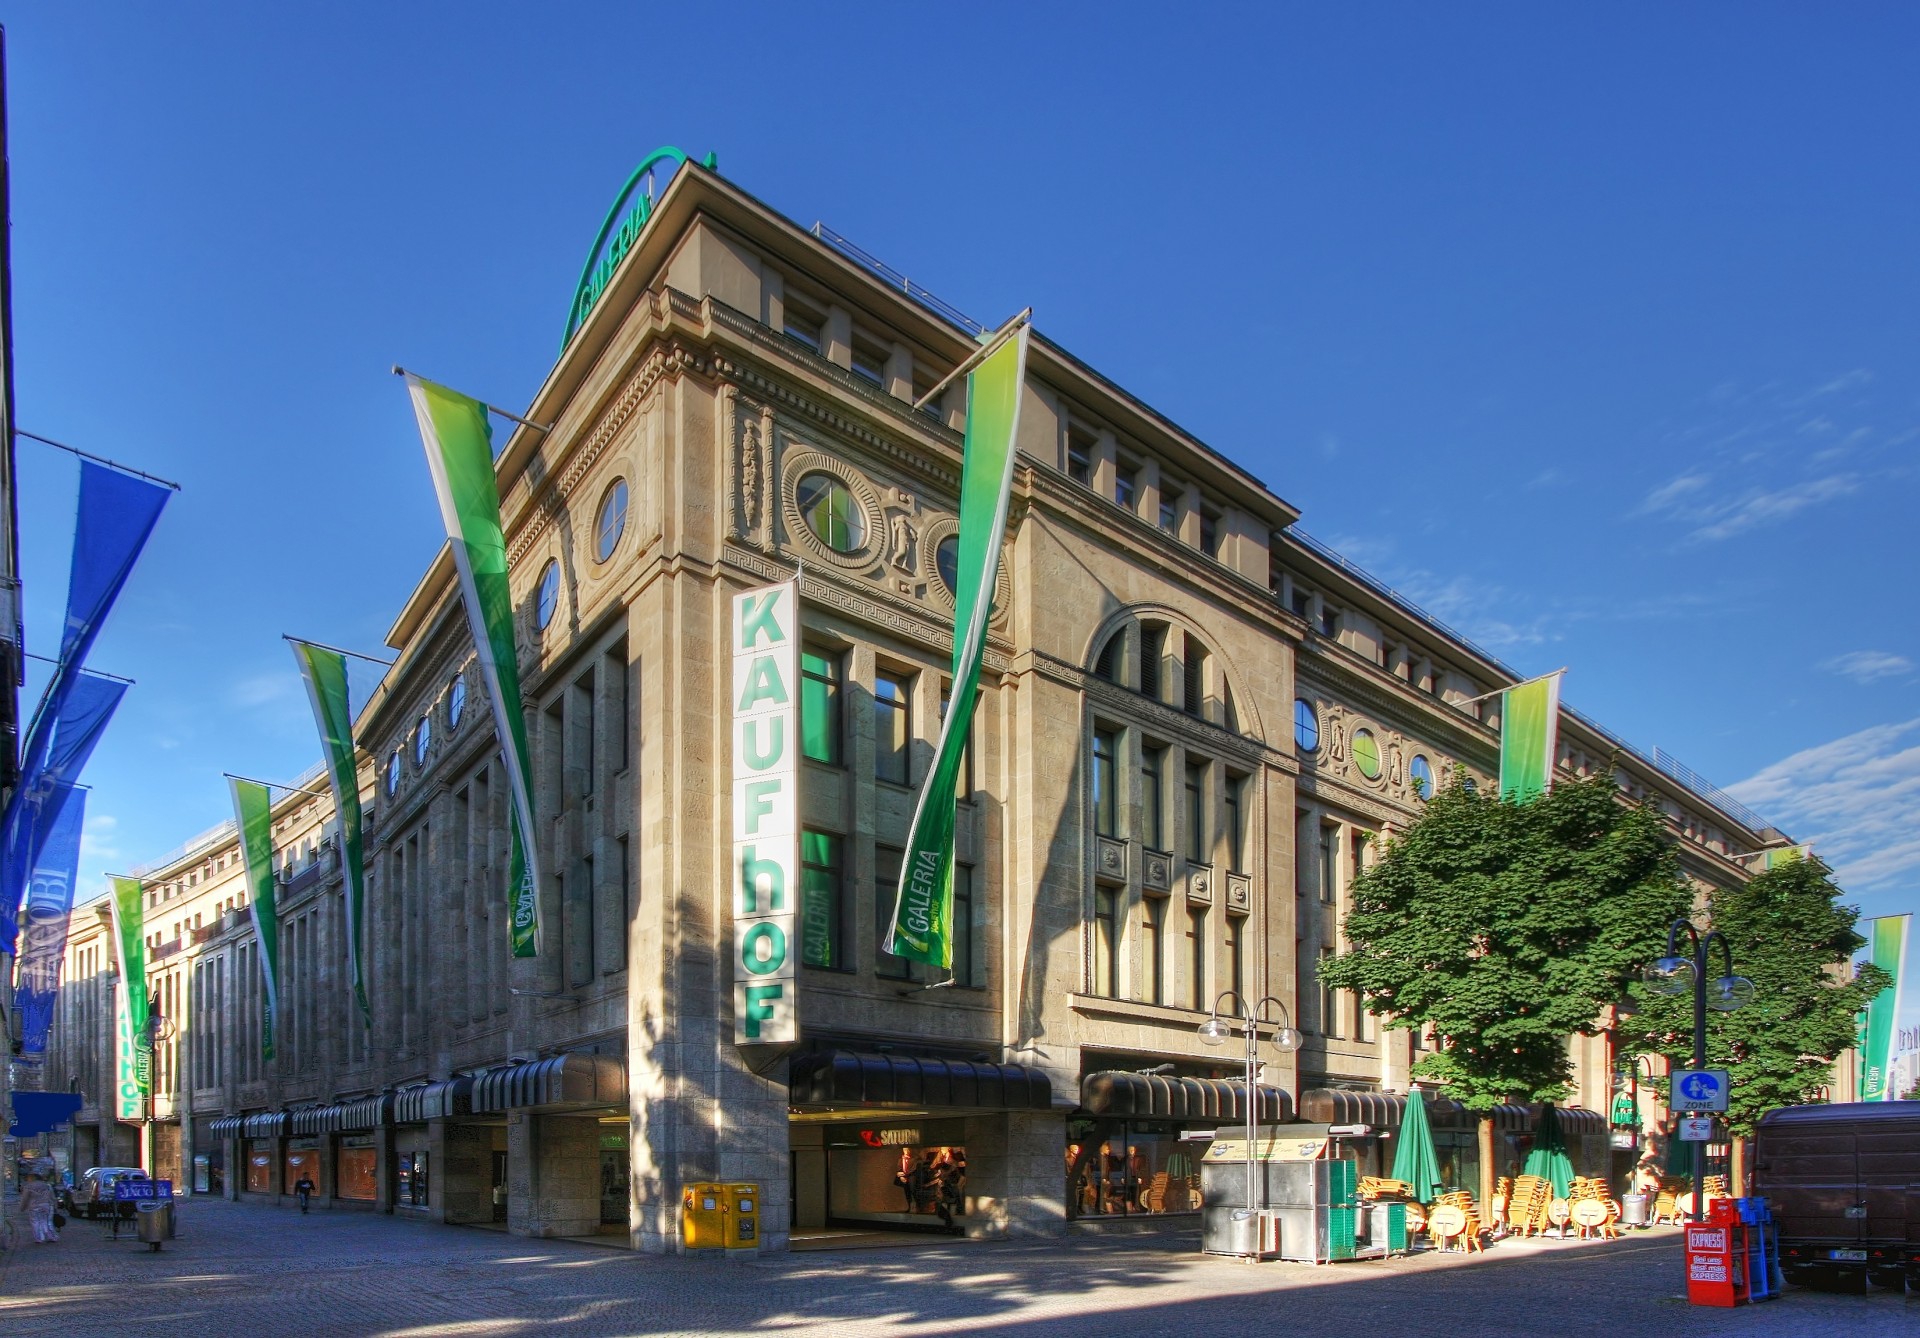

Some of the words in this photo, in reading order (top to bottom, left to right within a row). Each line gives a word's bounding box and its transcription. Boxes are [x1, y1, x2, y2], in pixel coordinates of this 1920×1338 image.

[579, 193, 651, 325] GALERIA
[906, 850, 940, 933] GALERIA
[1684, 1101, 1714, 1109] ZONE
[880, 1129, 920, 1145] SATURN
[1691, 1233, 1722, 1248] EXPRESS
[1690, 1272, 1727, 1280] EXPRESS
